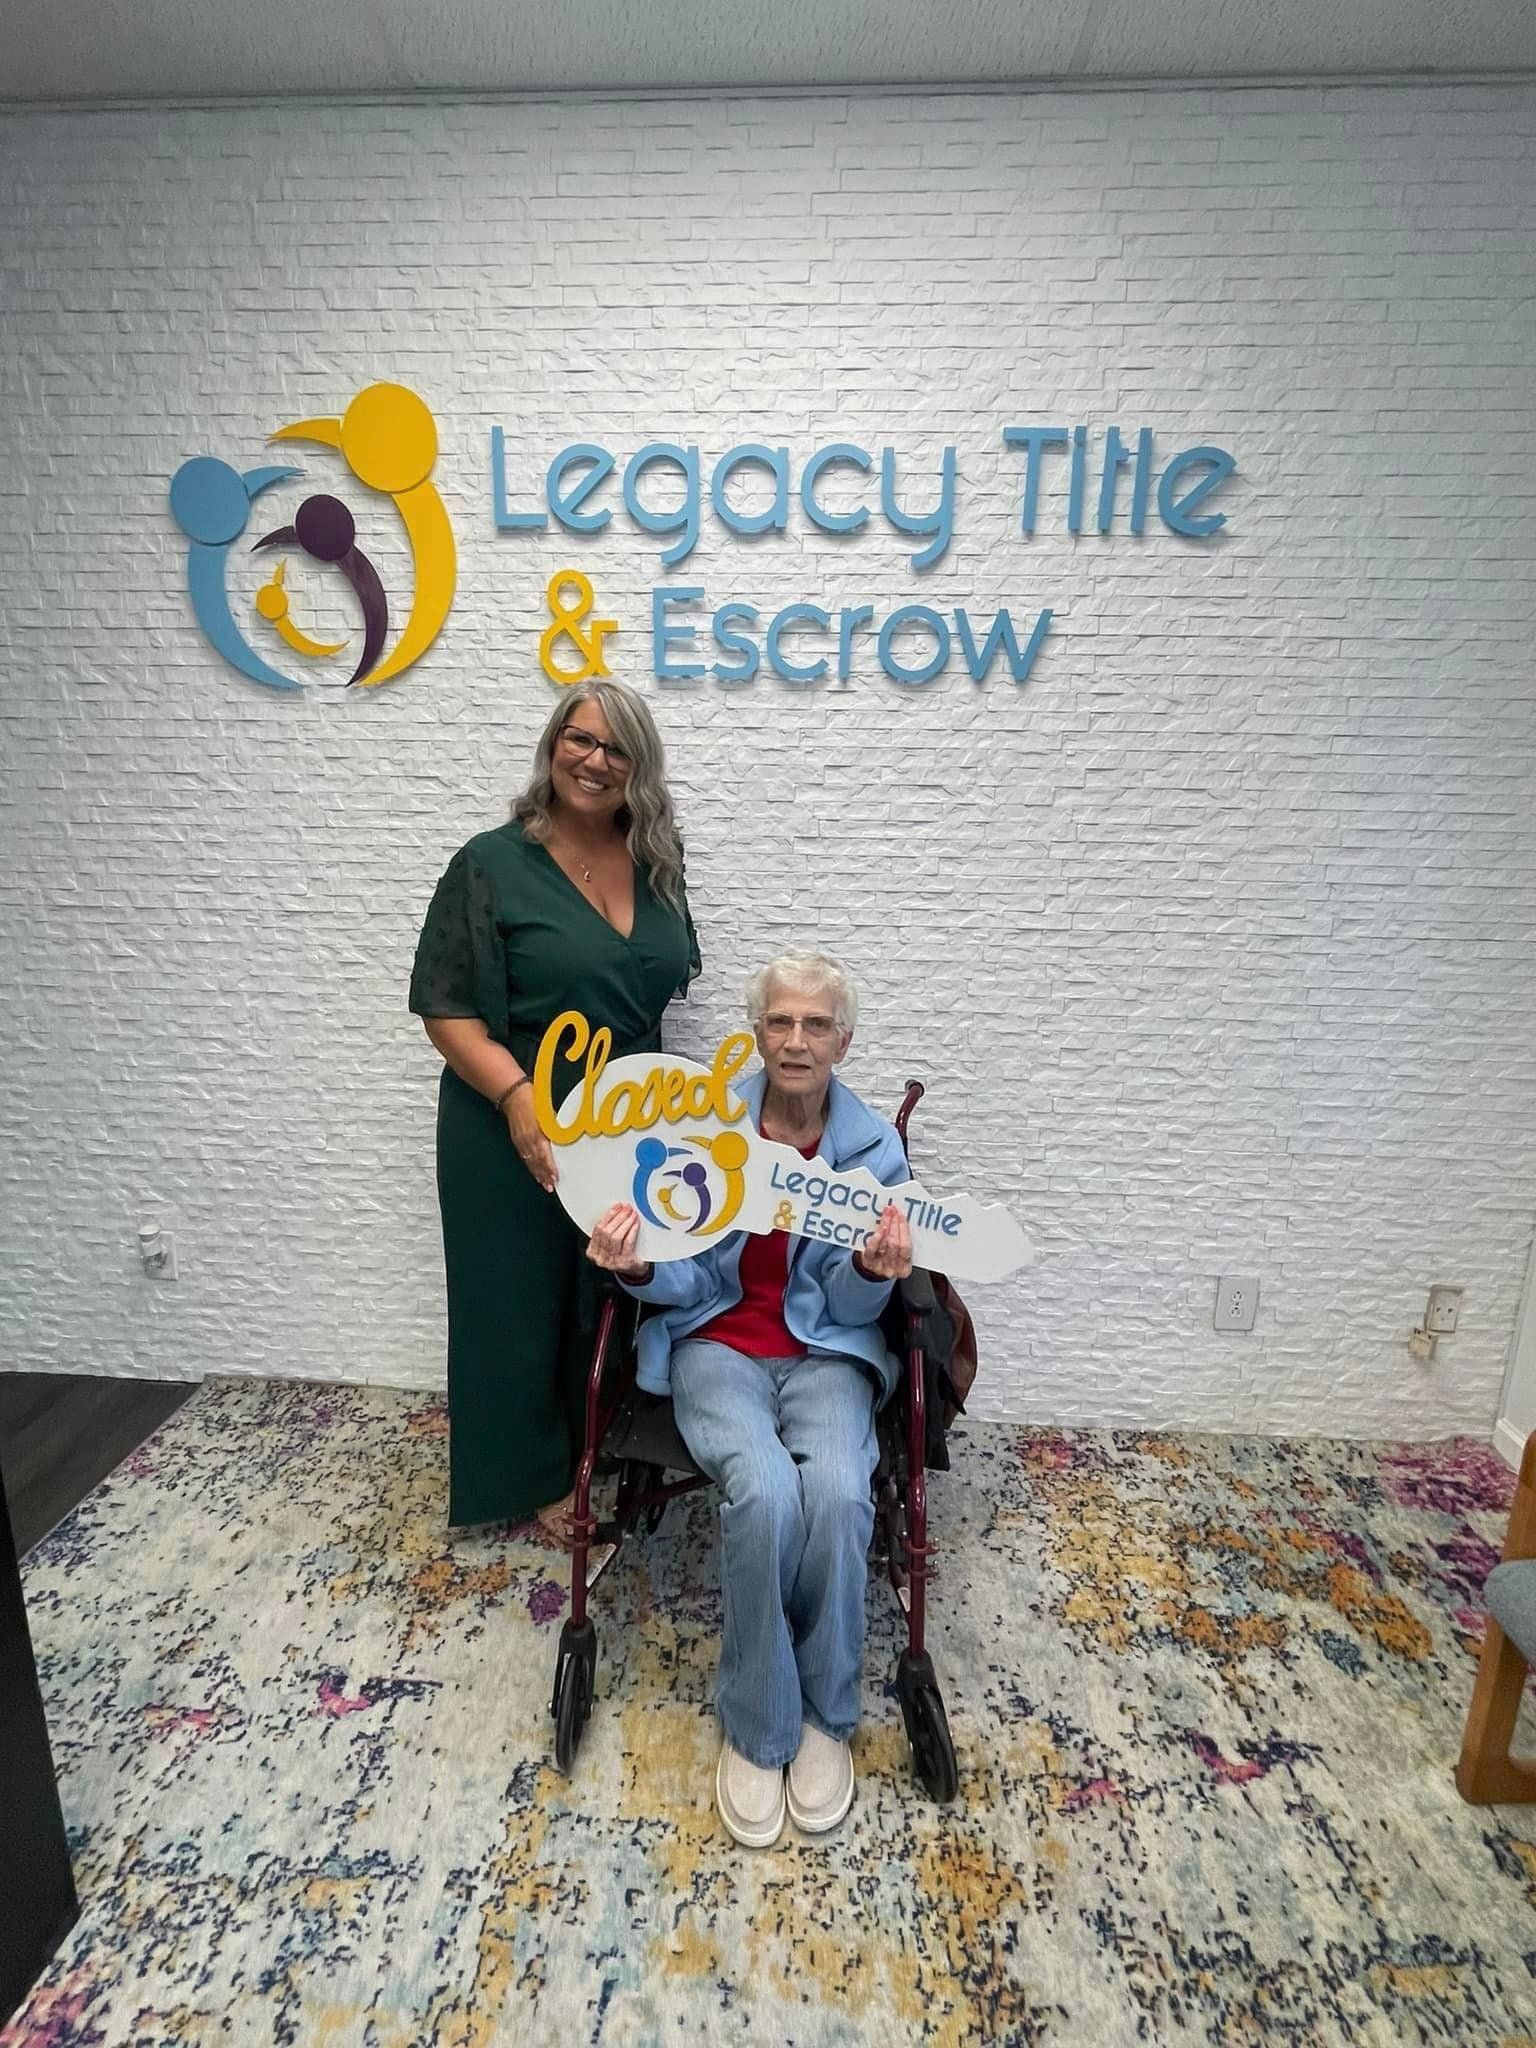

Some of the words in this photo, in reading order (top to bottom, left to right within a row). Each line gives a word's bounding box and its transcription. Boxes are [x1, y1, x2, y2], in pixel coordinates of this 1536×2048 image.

[491, 425, 956, 570] Legacy
[1002, 427, 1238, 537] Title
[540, 569, 618, 683] &
[652, 586, 1053, 684] Escrow
[534, 1010, 755, 1145] Closed
[773, 1200, 797, 1230] &
[904, 1197, 962, 1236] Title
